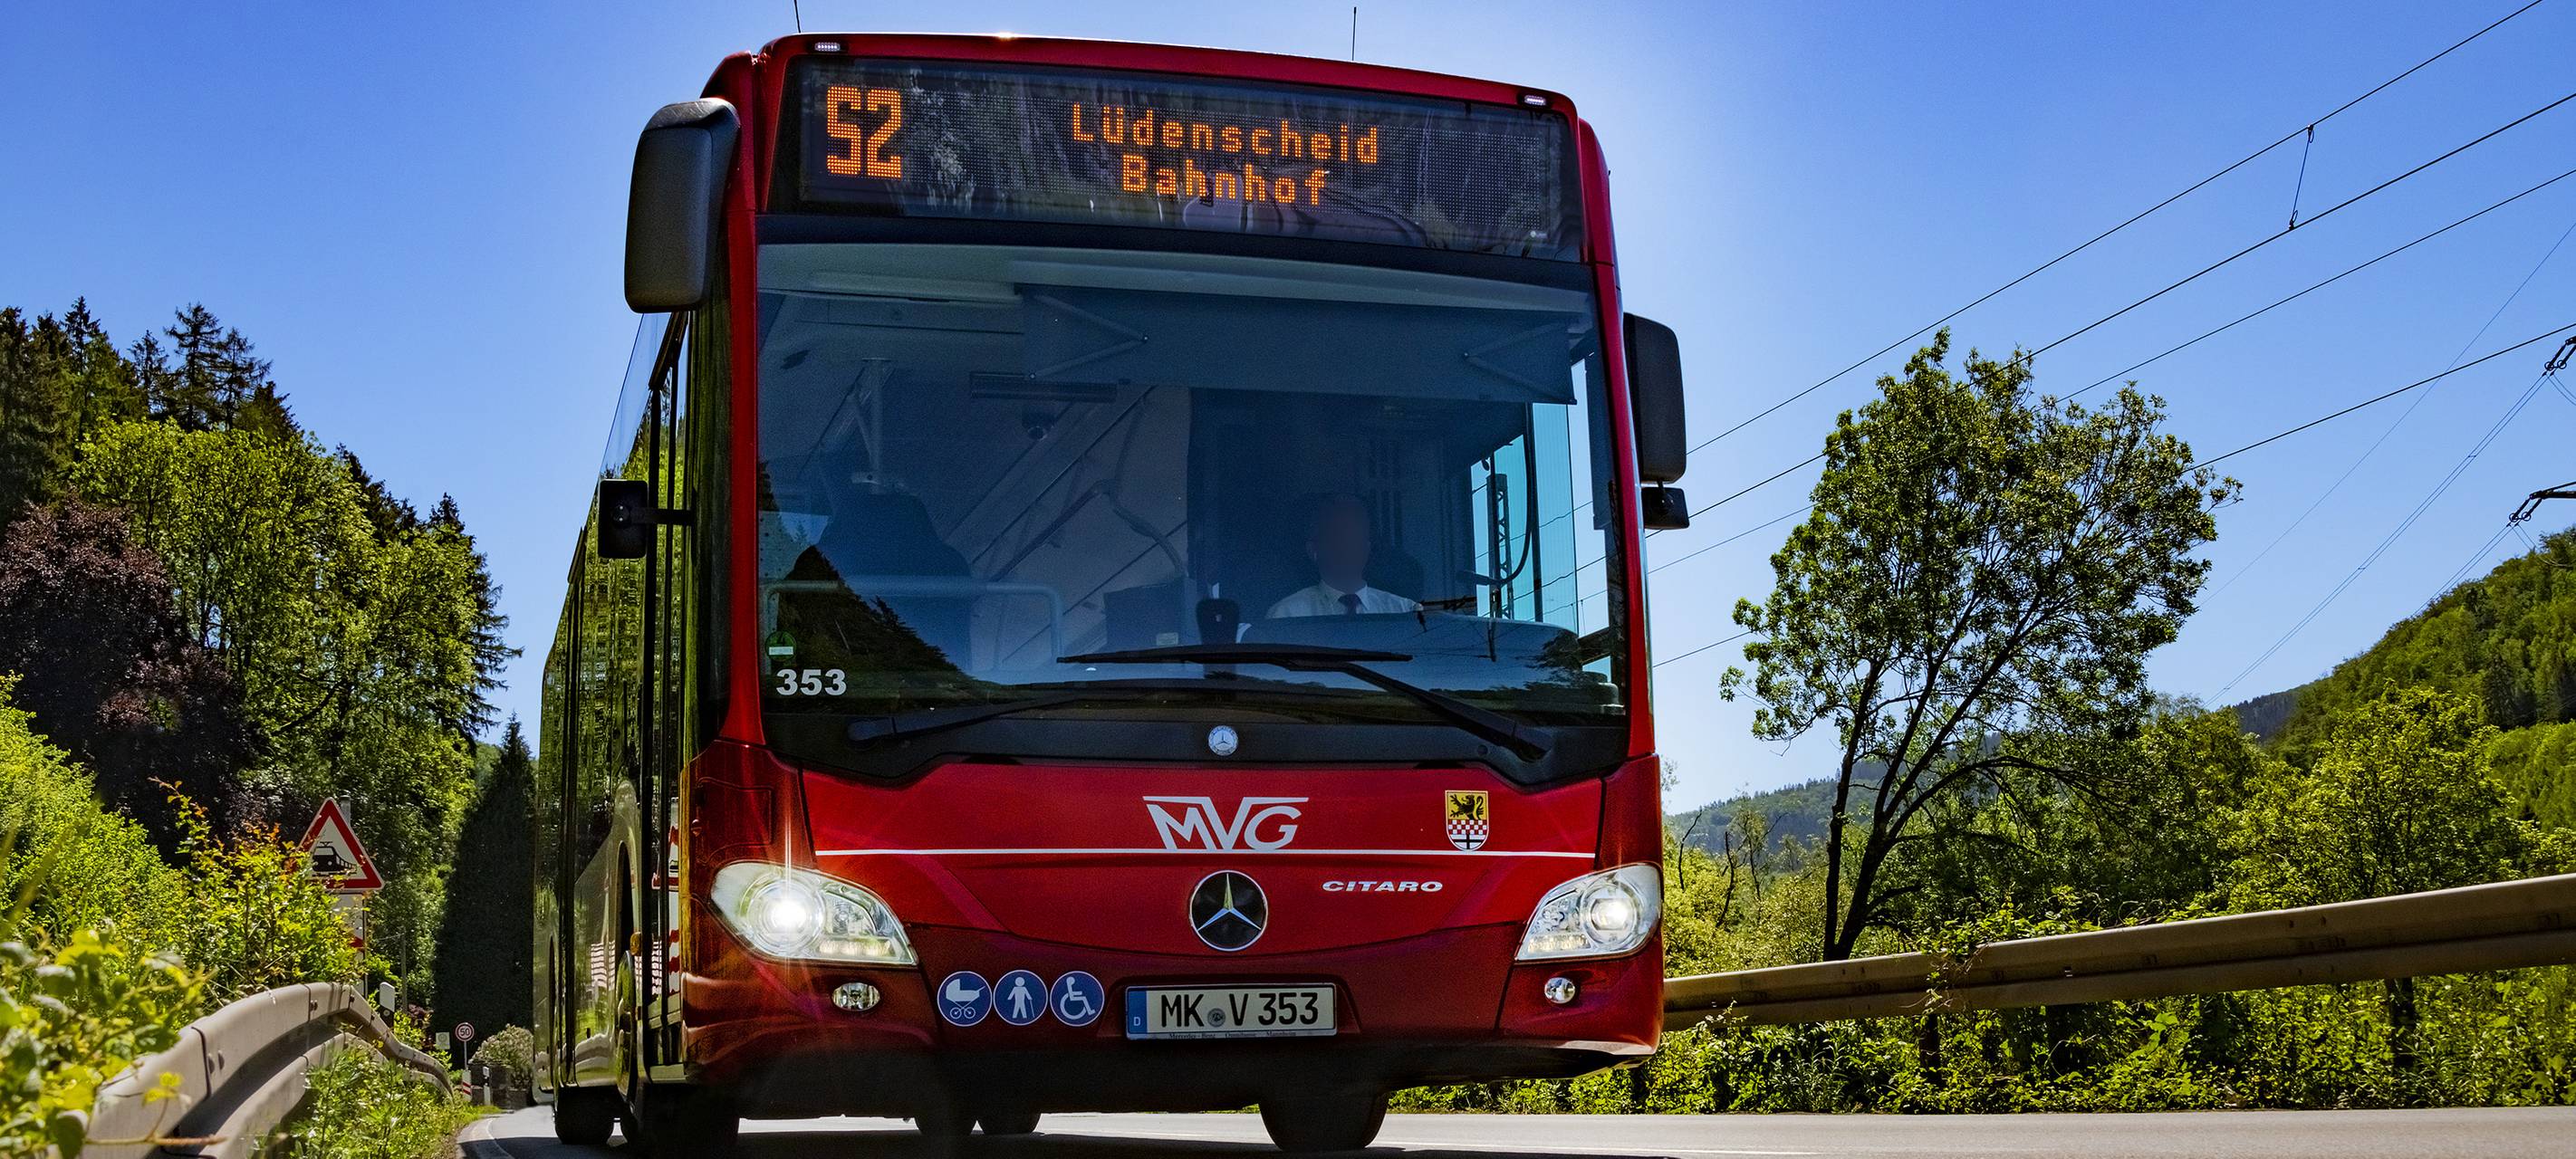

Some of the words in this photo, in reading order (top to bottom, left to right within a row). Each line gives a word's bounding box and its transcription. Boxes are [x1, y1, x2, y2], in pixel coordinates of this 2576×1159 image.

[827, 86, 901, 178] S2
[1072, 103, 1378, 164] Lüdenscheid
[1122, 154, 1326, 206] Bahnhof
[776, 668, 847, 696] 353
[1142, 796, 1310, 850] MVG
[1322, 880, 1443, 892] CITARO
[1133, 1017, 1141, 1026] D
[1161, 994, 1205, 1028] MK
[1229, 992, 1249, 1026] V
[1258, 991, 1319, 1026] 353
